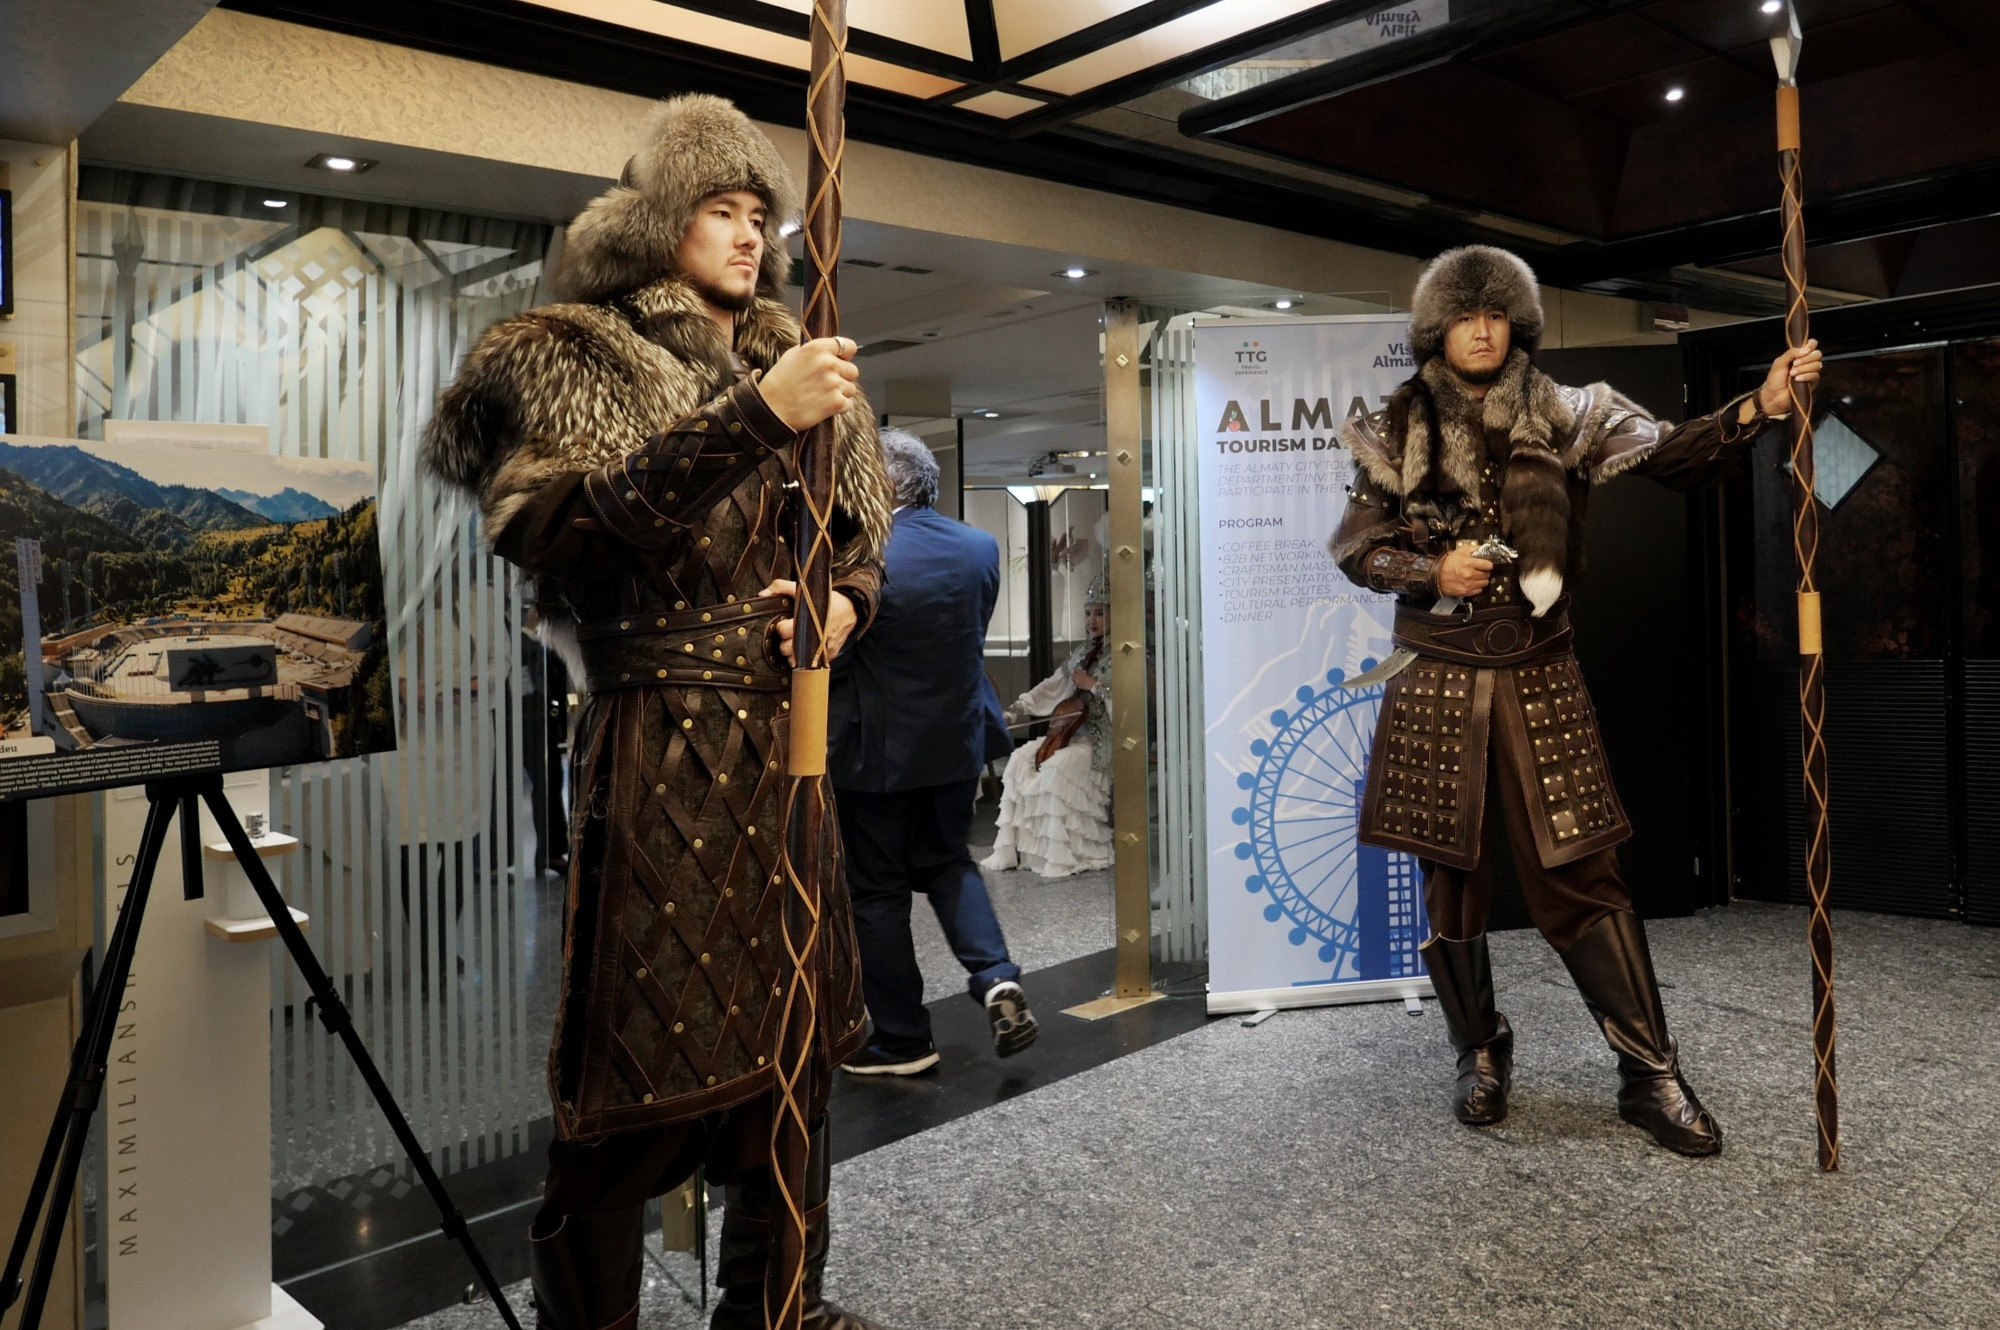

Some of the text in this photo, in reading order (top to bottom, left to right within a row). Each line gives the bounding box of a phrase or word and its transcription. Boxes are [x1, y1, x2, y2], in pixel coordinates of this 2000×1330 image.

[1388, 343, 1413, 355] Vis
[1235, 351, 1267, 363] TTG
[1372, 355, 1414, 368] Alma
[1217, 396, 1393, 433] ALMA
[1217, 437, 1348, 454] TOURISM DA
[1218, 460, 1351, 474] THE ALMATY CITY TOU
[1218, 472, 1350, 486] DEPARTMENT INVITES
[1218, 485, 1294, 497] PARTICIPATE
[1297, 485, 1310, 494] IN
[1314, 484, 1337, 493] THE
[1219, 518, 1283, 529] PROGRAM
[1222, 539, 1315, 552] COFFEE BREAK
[1223, 553, 1247, 564] B2B
[1223, 563, 1298, 576] CRAFTSMAN
[1223, 572, 1344, 588] CITY PRESENTATION
[1223, 585, 1331, 599] TOURISM ROUTES
[1224, 593, 1392, 611] CULTURAL PERFORMANCES
[1224, 611, 1273, 623] DINNER
